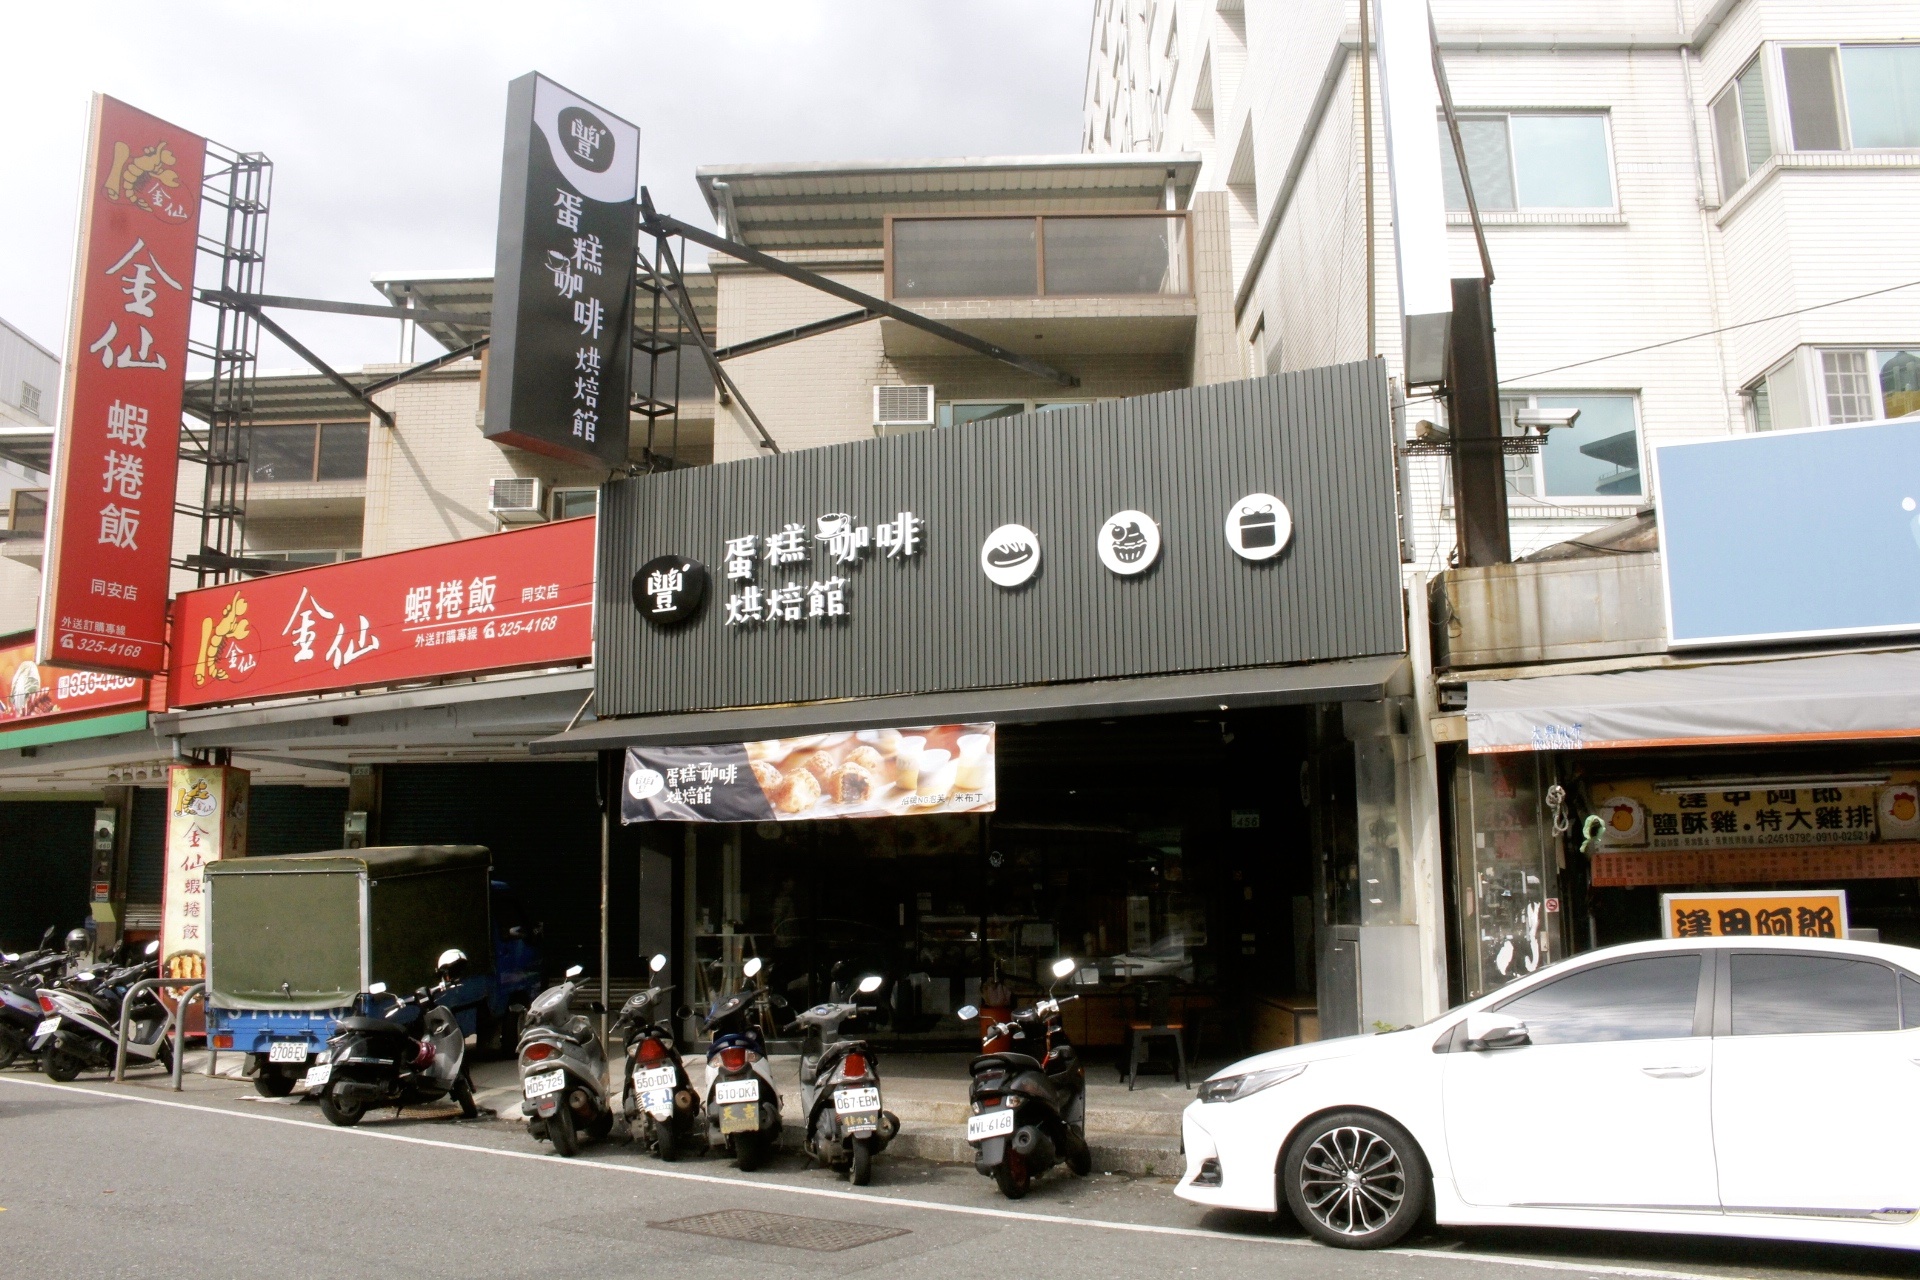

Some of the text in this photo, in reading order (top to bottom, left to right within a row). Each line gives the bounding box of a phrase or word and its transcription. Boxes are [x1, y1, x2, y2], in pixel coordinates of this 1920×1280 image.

[571, 117, 602, 163] 豐
[148, 182, 188, 219] 金仙
[90, 237, 184, 372] 金仙
[572, 347, 602, 443] 烘焙館
[97, 399, 150, 552] 蝦捲飯
[724, 511, 921, 580] 蛋糕 咖啡
[91, 579, 138, 601] 同安店
[404, 575, 497, 624] 蝦捲飯
[521, 584, 559, 604] 同安店
[646, 566, 684, 613] 豐
[725, 576, 847, 626] 烘焙館
[61, 616, 126, 636] 外送訂購專線
[77, 638, 142, 658] 325-4168
[282, 586, 380, 670] 金仙
[415, 627, 478, 648] 外送訂購專線
[498, 616, 558, 638] 325-4168
[225, 641, 256, 673] 金仙
[664, 786, 713, 805] 烘焙館
[666, 764, 738, 788] 蛋糕 咖啡
[181, 821, 210, 872] 金仙
[182, 878, 201, 940] 蝦捲飯
